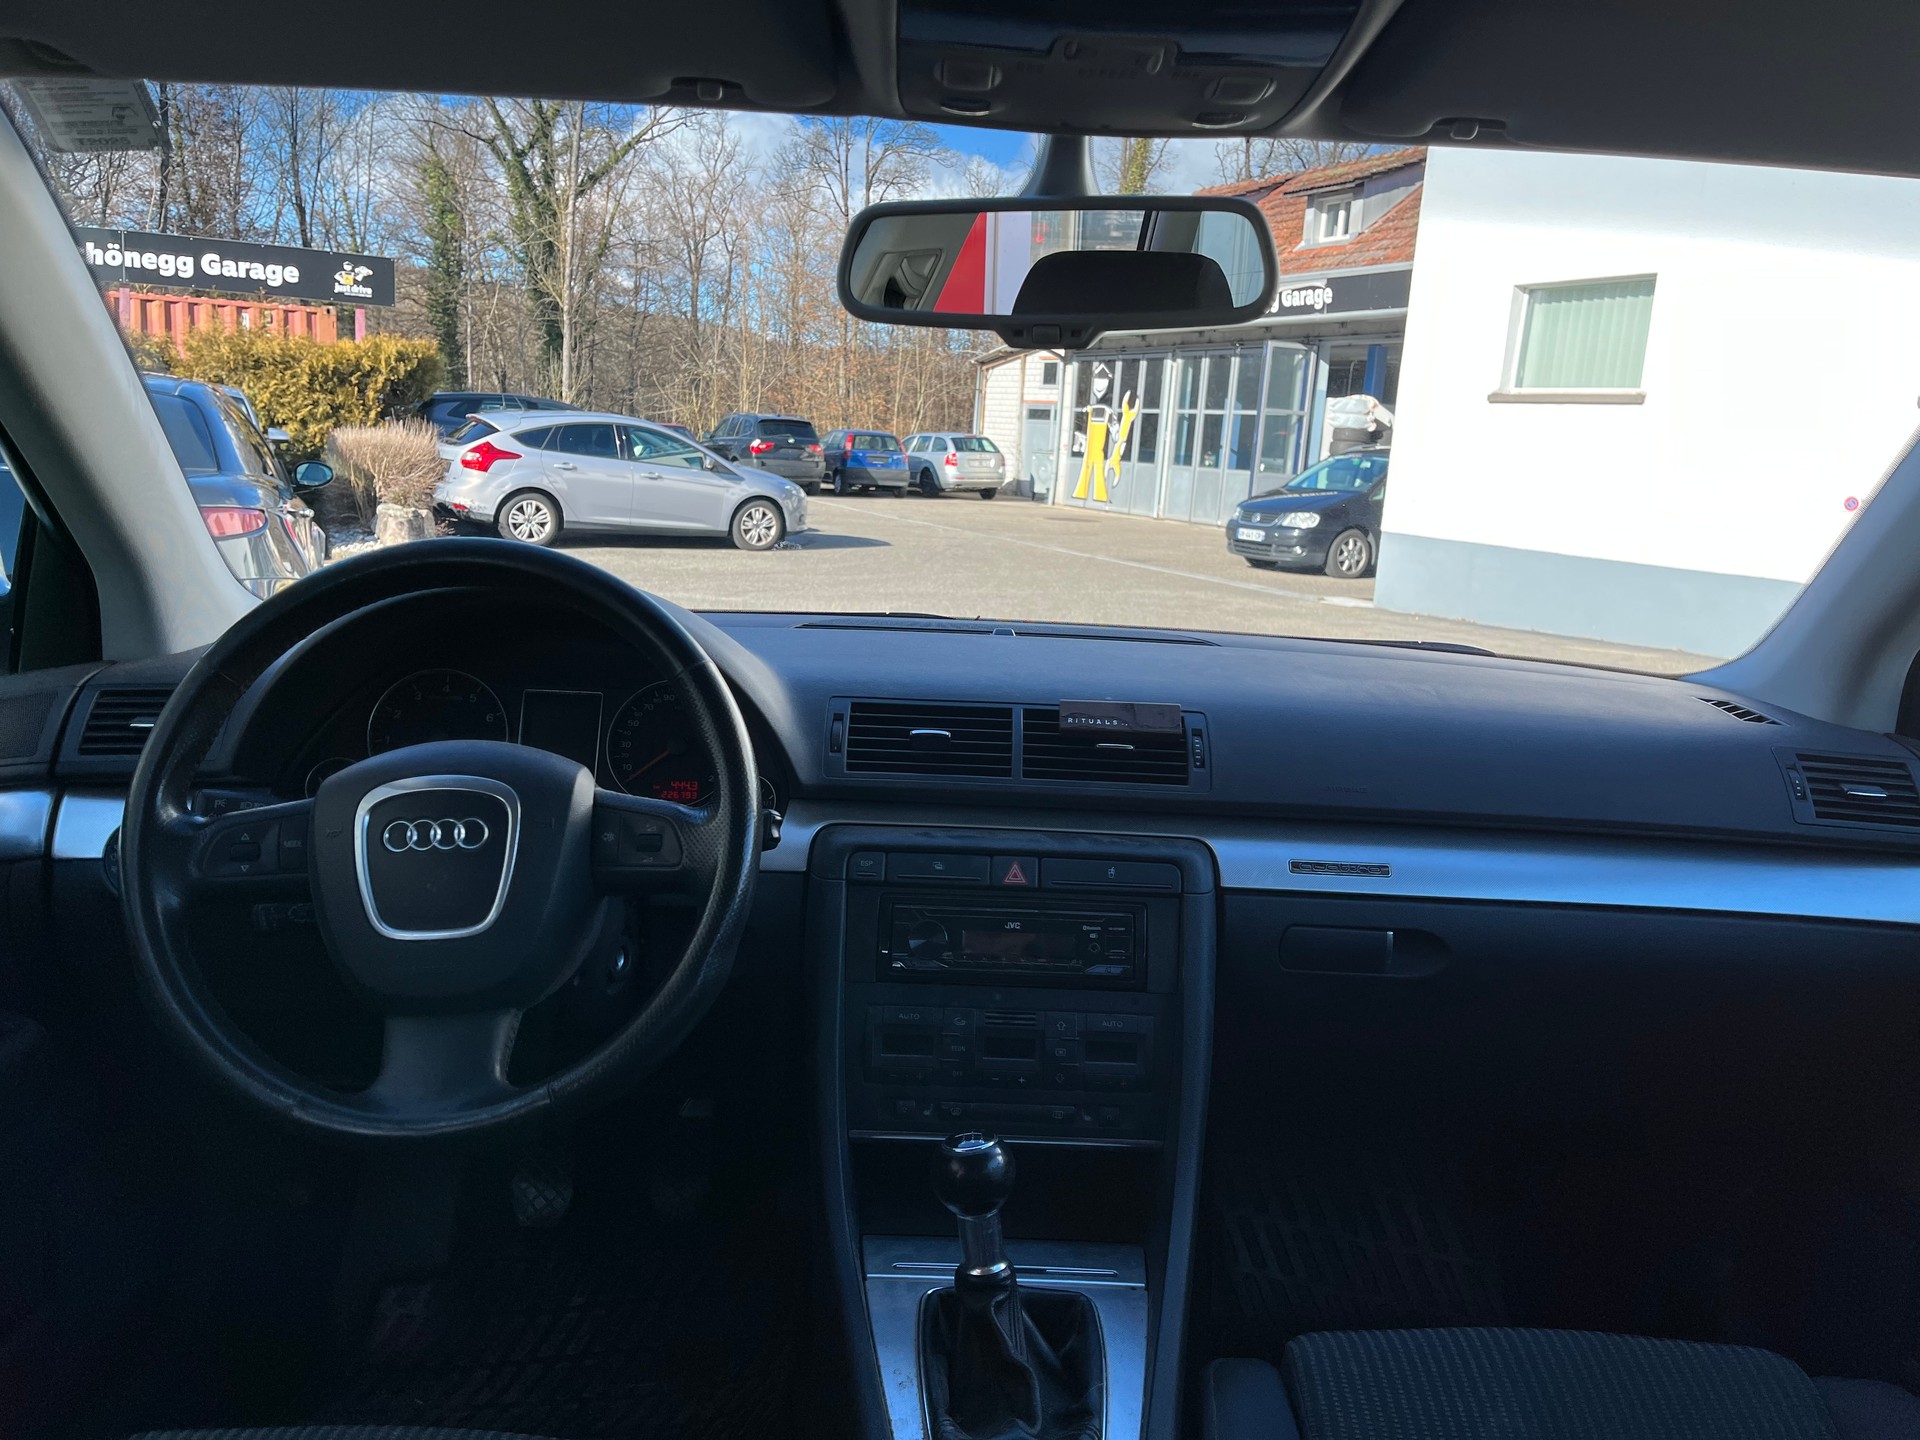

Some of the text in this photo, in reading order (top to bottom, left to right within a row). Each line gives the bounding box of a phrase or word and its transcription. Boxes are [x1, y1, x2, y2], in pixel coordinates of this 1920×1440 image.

[200, 253, 299, 287] Garage
[351, 284, 372, 295] drive
[1281, 287, 1333, 310] Garage
[643, 703, 654, 711] 70
[486, 713, 494, 722] 6
[627, 719, 640, 727] 50
[623, 763, 633, 771] 10
[1102, 1020, 1123, 1028] AUTO
